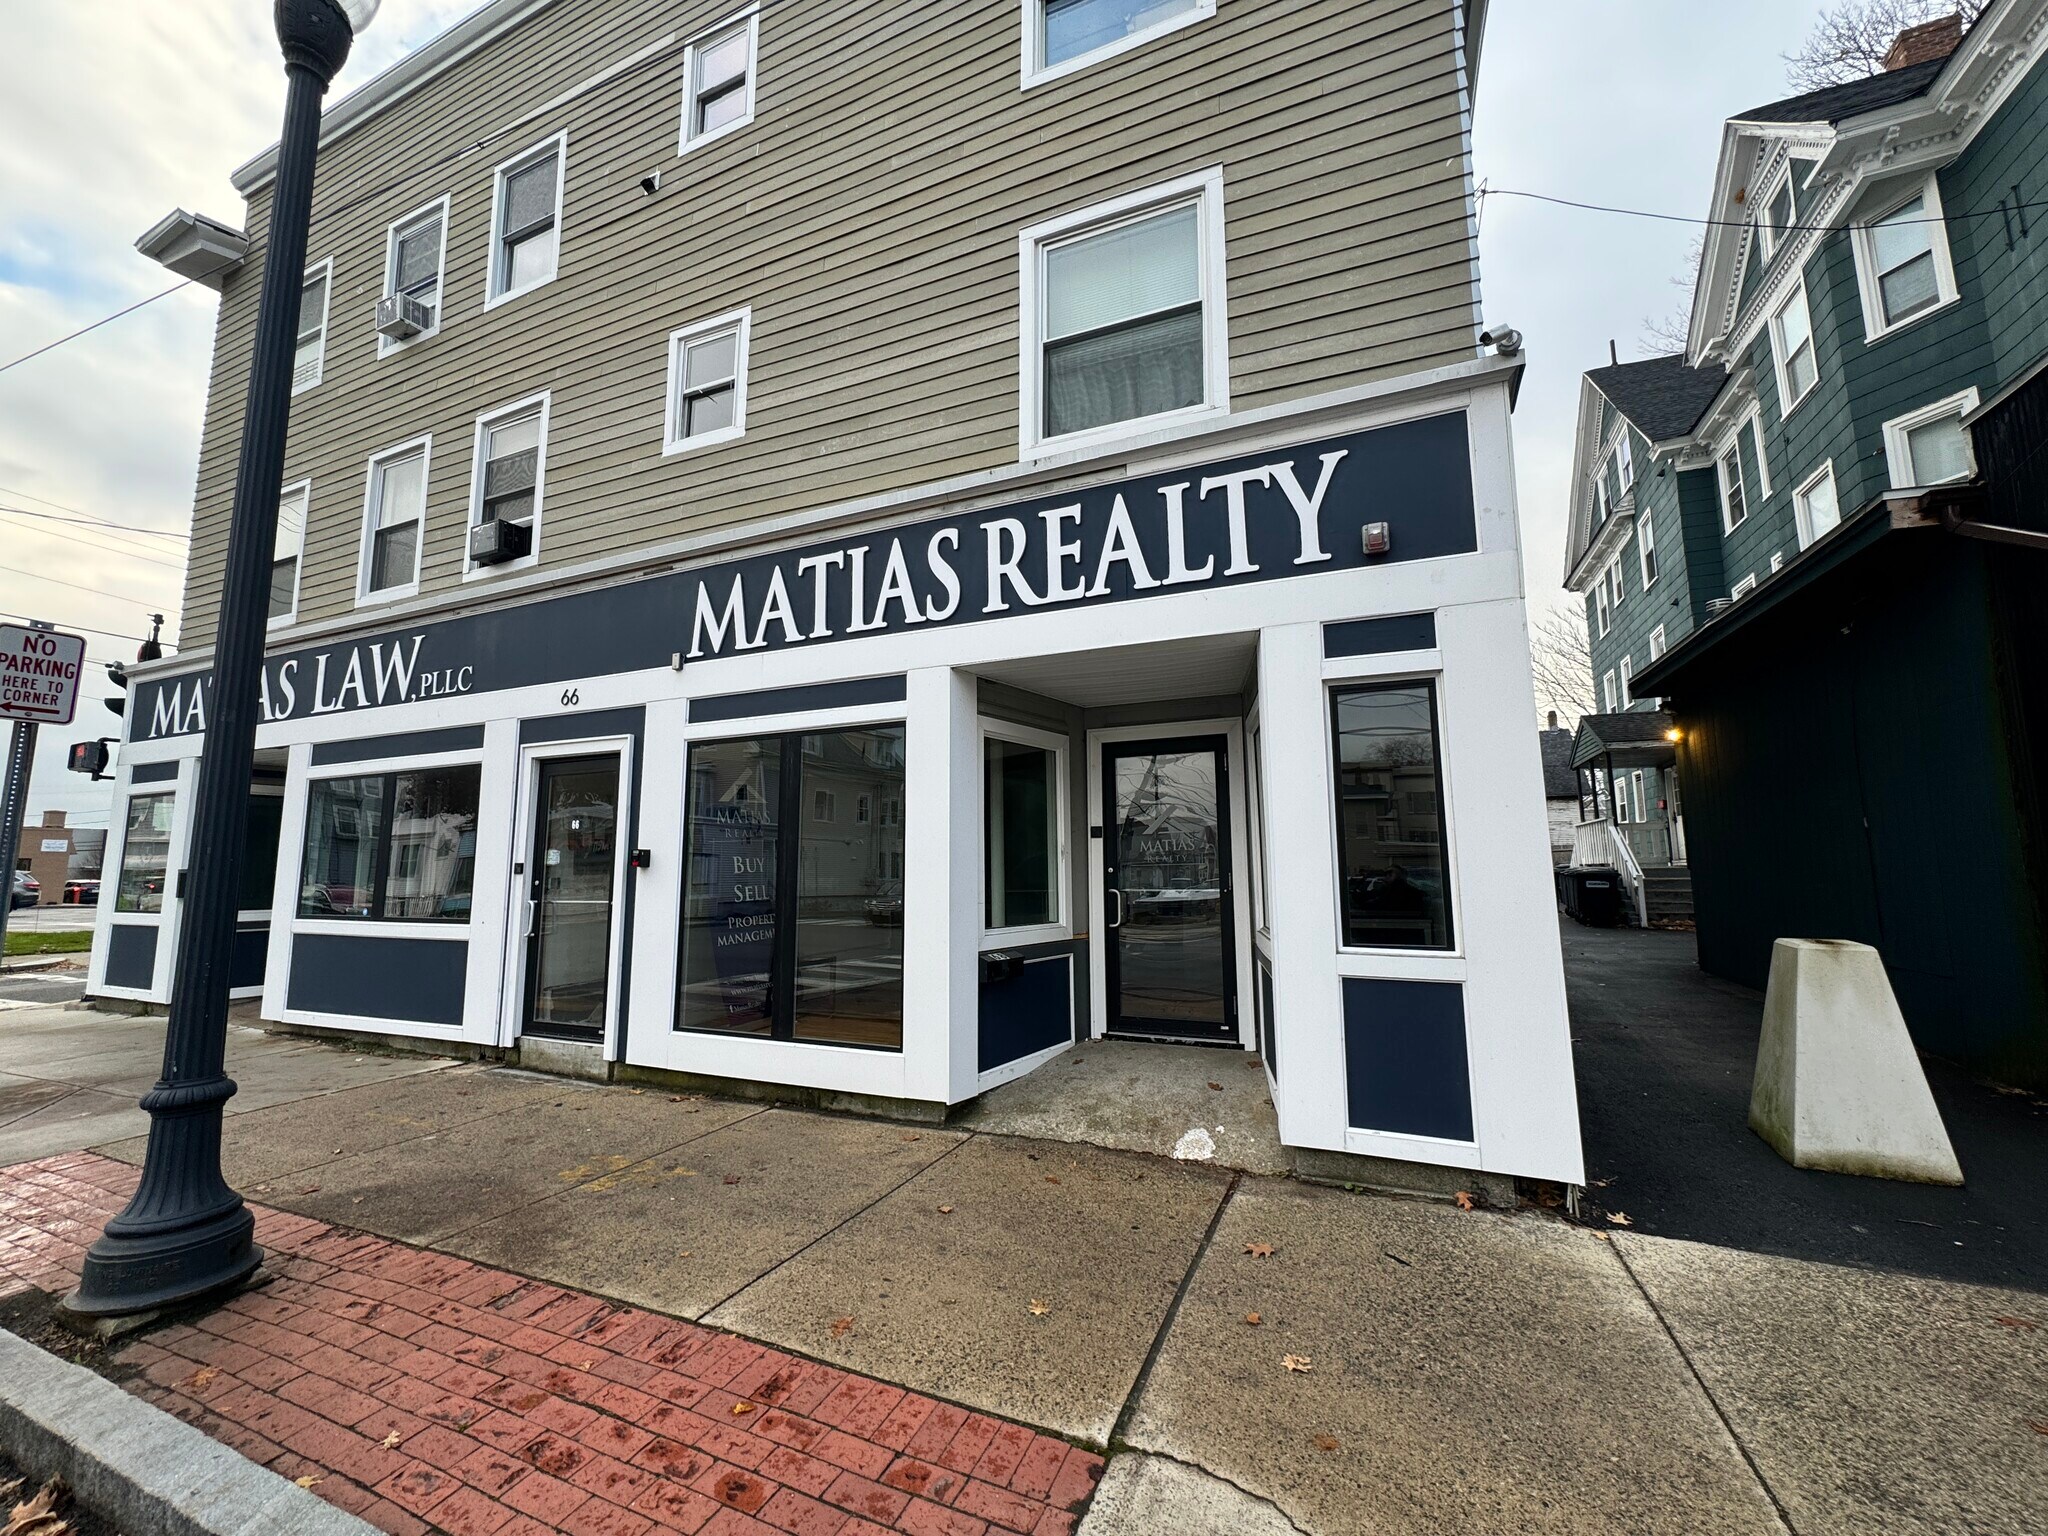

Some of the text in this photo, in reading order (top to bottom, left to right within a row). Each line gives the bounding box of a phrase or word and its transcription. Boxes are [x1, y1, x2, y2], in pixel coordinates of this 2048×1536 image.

[687, 449, 1349, 658] MATIAS REALTY
[22, 636, 57, 656] NO
[0, 652, 76, 680] PARKING
[2, 674, 64, 693] HERE TO
[3, 688, 59, 706] CORNER
[148, 659, 298, 738] MAAS
[419, 665, 474, 697] PLLC
[561, 688, 579, 705] 66
[572, 820, 580, 829] 66
[1140, 840, 1195, 852] MATIAS
[733, 856, 765, 874] BUY
[1147, 854, 1188, 863] REALTY
[734, 884, 770, 902] SELL
[728, 913, 776, 929] PROPERT
[717, 928, 776, 947] MANAGEM
